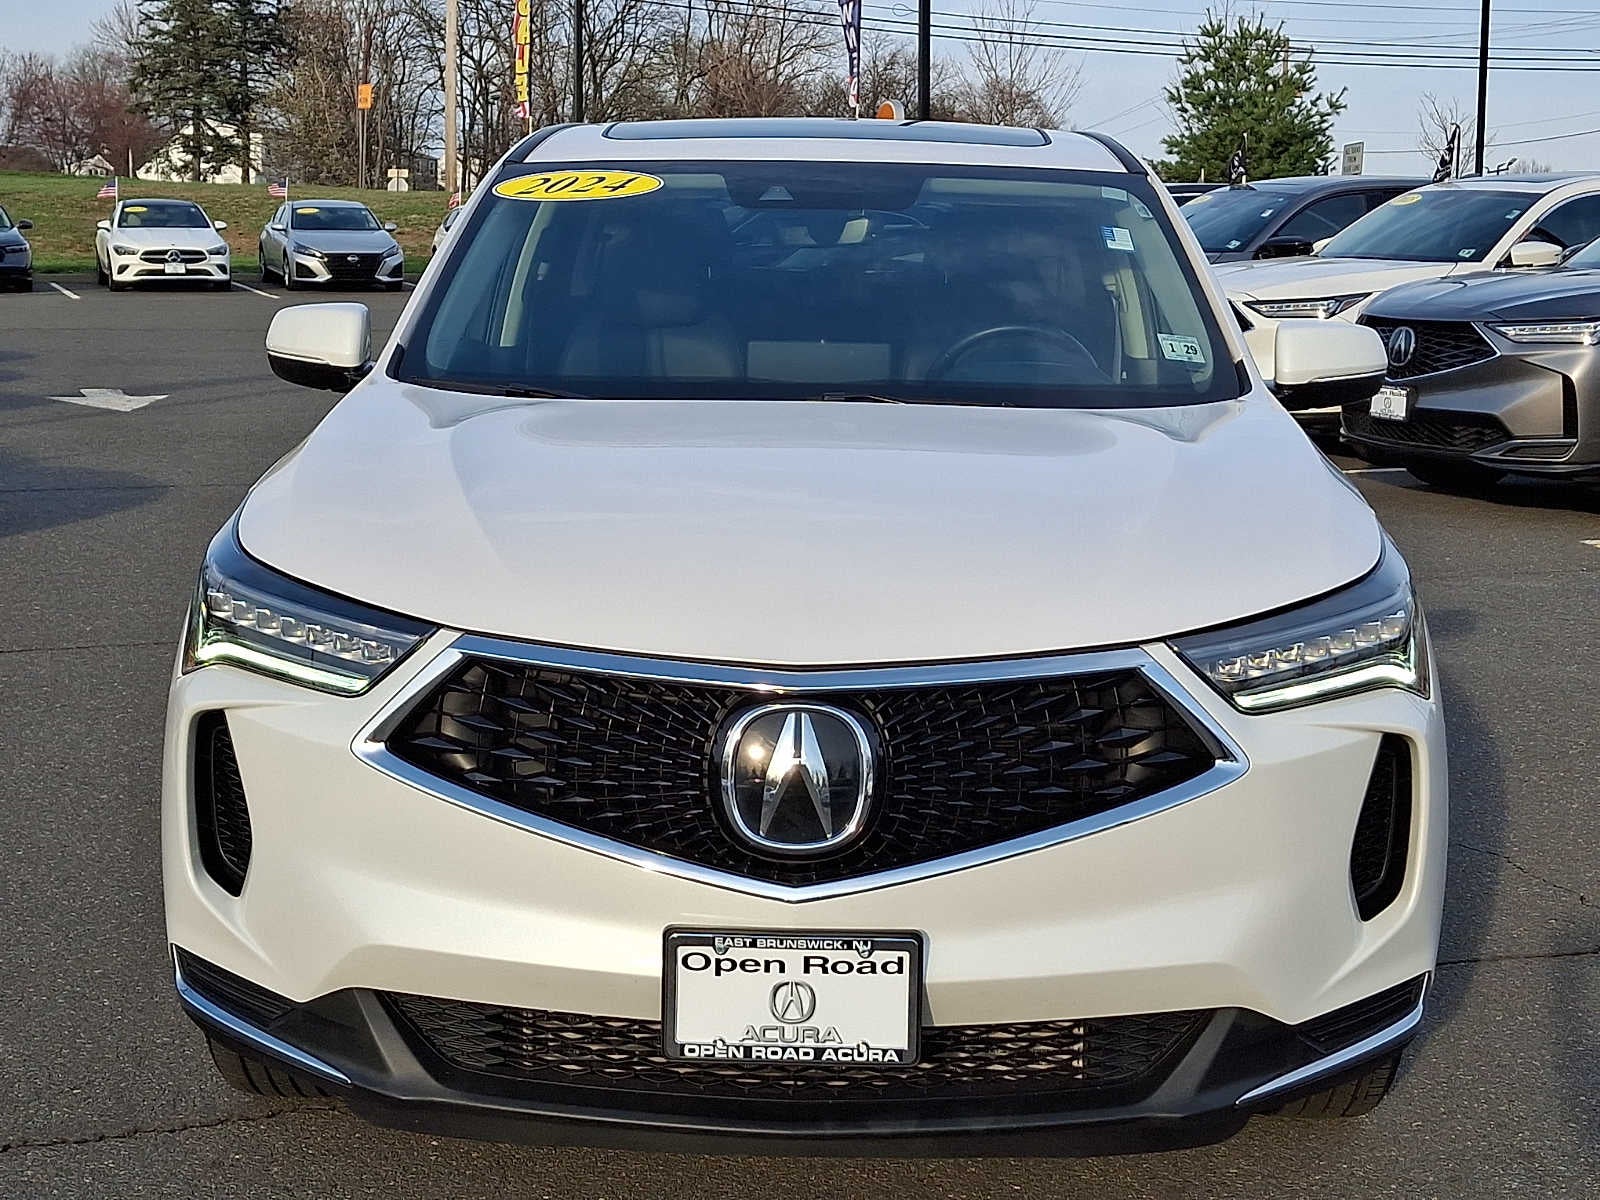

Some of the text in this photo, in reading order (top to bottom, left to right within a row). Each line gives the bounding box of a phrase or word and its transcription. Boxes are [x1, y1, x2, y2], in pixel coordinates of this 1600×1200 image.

[513, 175, 641, 196] 2024
[1168, 342, 1198, 355] 1 29
[714, 937, 752, 948] EAST
[852, 940, 872, 950] NJ
[681, 952, 904, 976] Open Road
[739, 1024, 843, 1044] ACURA
[683, 1043, 900, 1063] OPEN ROAD ACURA
